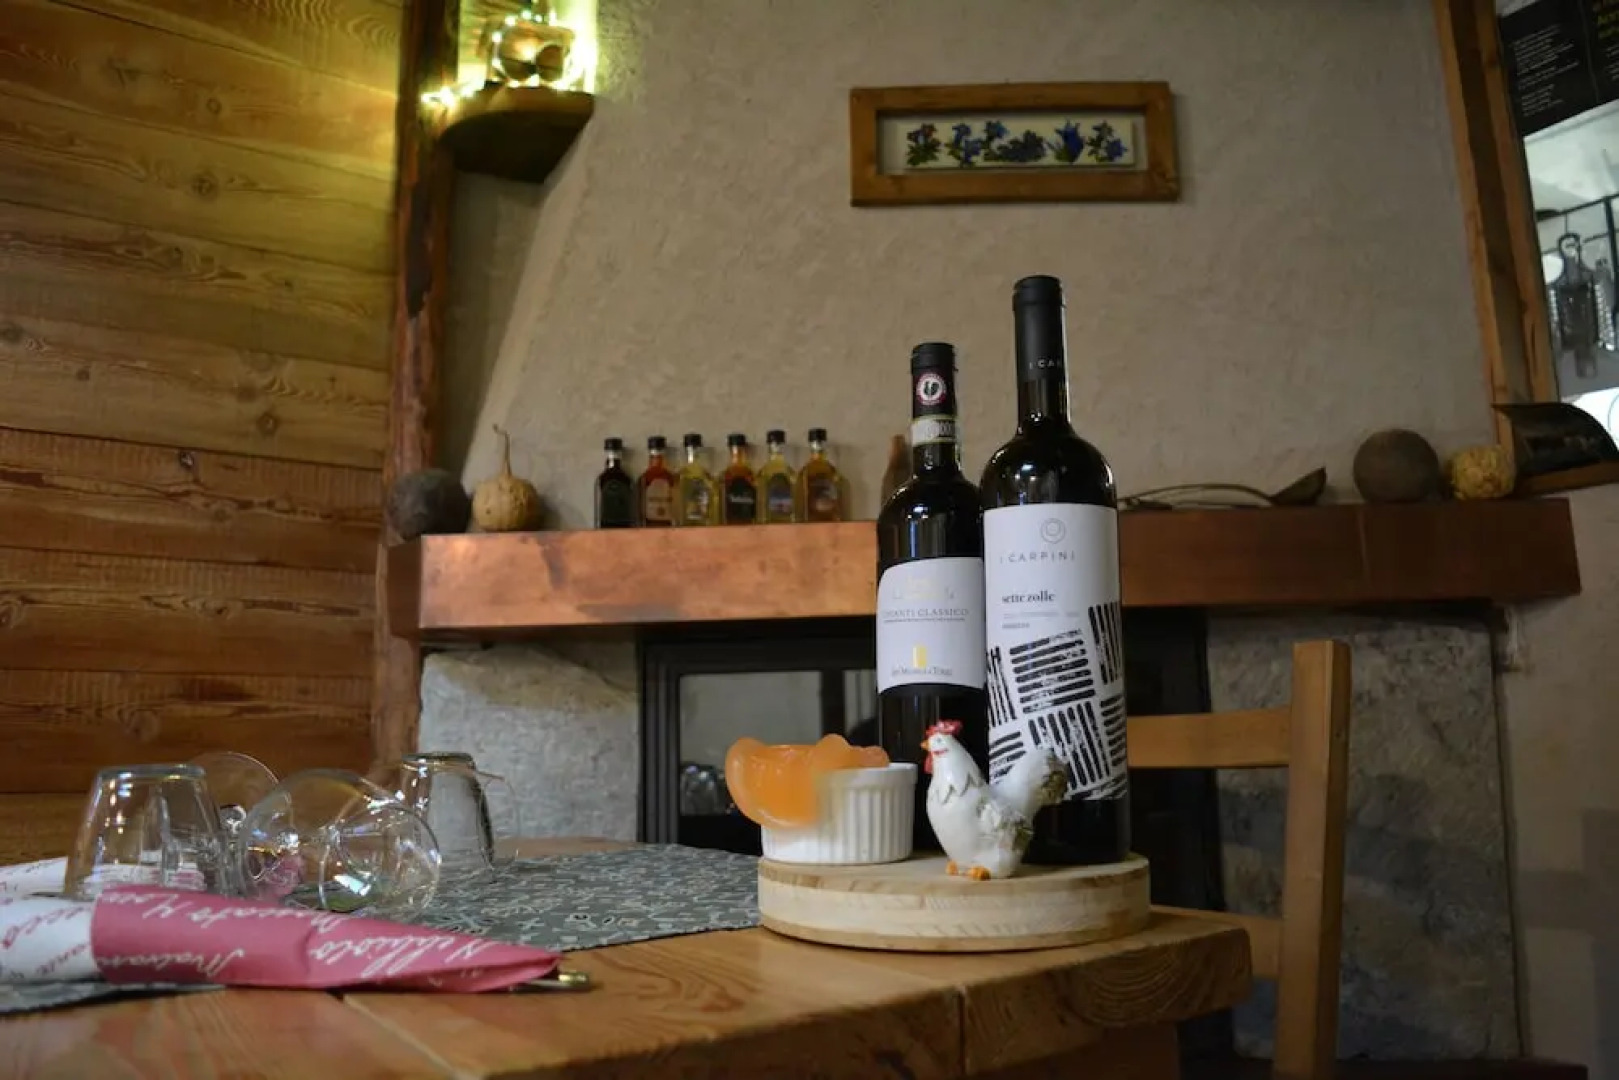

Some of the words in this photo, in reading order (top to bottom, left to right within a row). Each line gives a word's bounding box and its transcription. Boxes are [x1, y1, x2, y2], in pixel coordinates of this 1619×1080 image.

[1008, 549, 1075, 563] CARPINI
[1001, 593, 1026, 604] sette
[1027, 589, 1056, 603] zolle
[917, 607, 969, 617] CLASSICO
